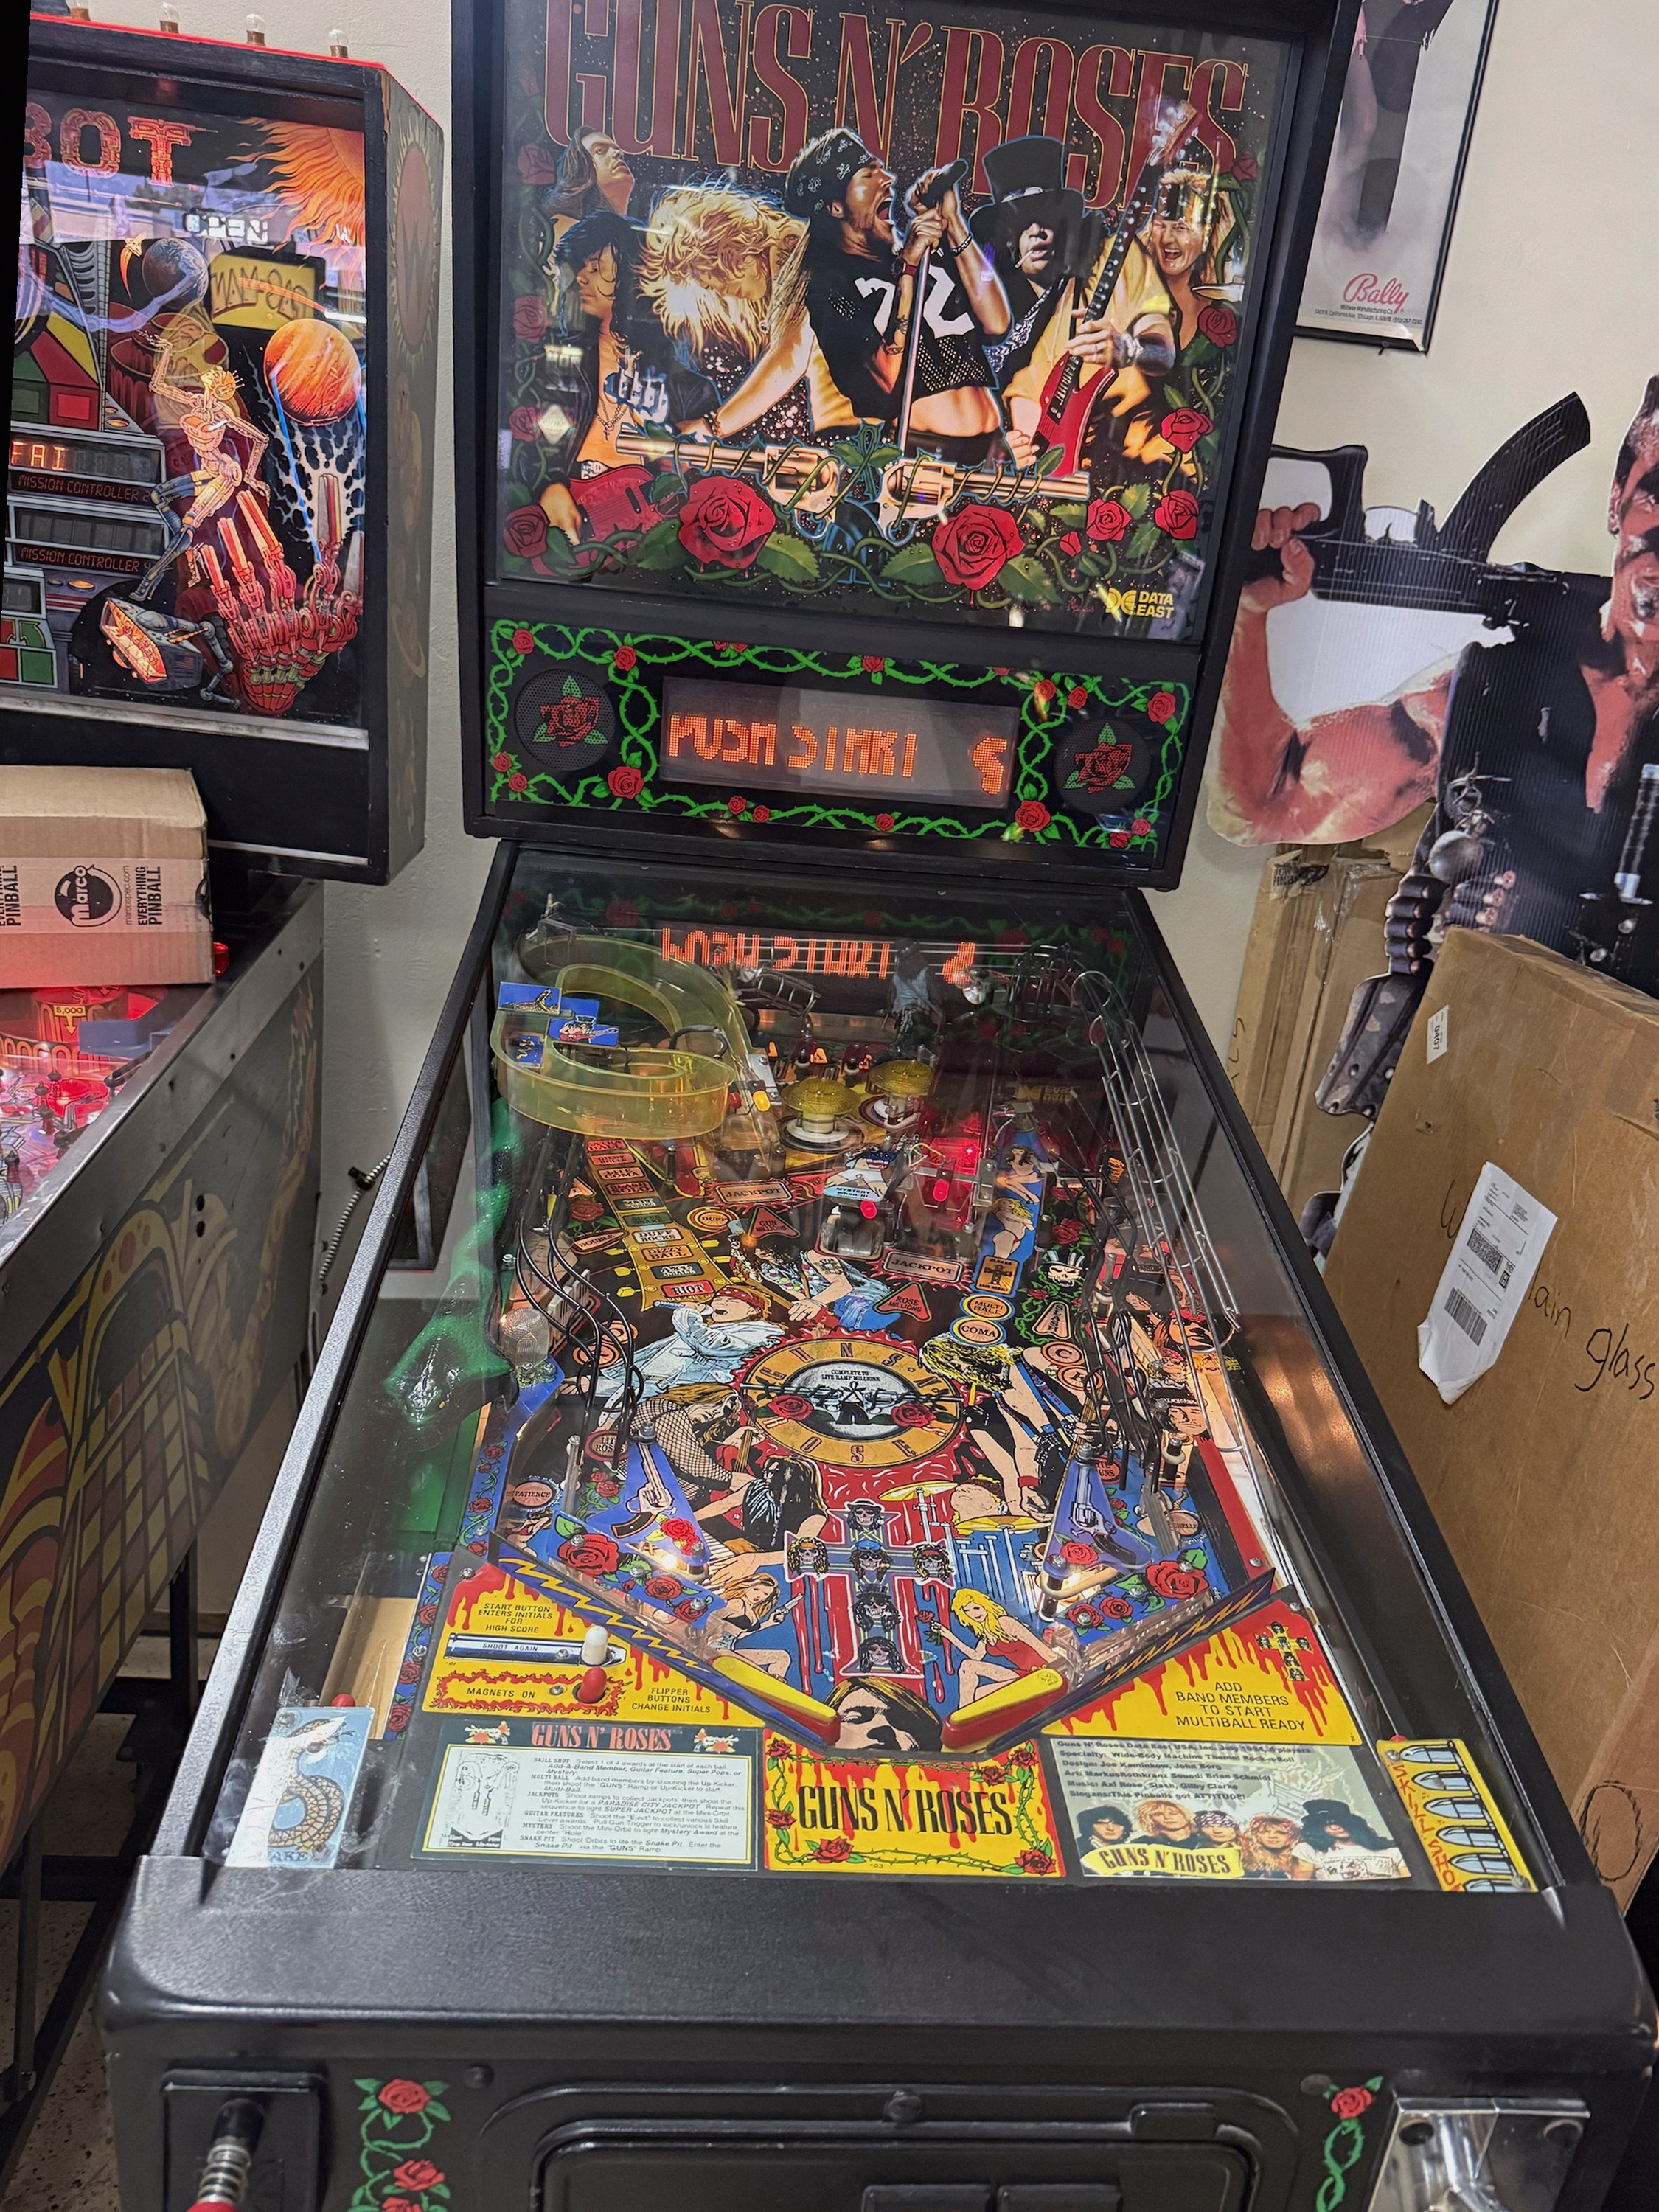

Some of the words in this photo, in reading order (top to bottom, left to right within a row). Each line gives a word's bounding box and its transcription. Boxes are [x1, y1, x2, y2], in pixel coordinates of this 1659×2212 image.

[544, 0, 813, 173] GUNS
[934, 25, 1248, 212] ROSES
[1343, 273, 1409, 314] Bally
[1357, 306, 1387, 314] Manufacturing
[18, 474, 63, 491] MISSION
[67, 481, 139, 501] CONTROLLER
[21, 547, 64, 563] MISSION
[69, 553, 139, 572] CONTROLLER
[1138, 591, 1173, 605] DATA
[1135, 604, 1175, 619] EAST
[3, 865, 21, 926] PINBALL
[71, 865, 90, 920] marco
[136, 866, 147, 925] EVERYTHING
[147, 866, 163, 925] PINBALL
[726, 1187, 782, 1197] JACKPOT
[835, 1186, 871, 1194] MYSTERY
[638, 1229, 674, 1237] DUFF
[579, 1234, 615, 1248] DOUBLE
[891, 1259, 955, 1276] JACKPOT
[672, 1284, 705, 1295] RIOT
[888, 1301, 922, 1312] MILLIONS
[896, 1295, 919, 1306] ROSE
[974, 1301, 1004, 1310] MULTI
[973, 1306, 1001, 1315] BALL
[1048, 1304, 1063, 1332] SLASH
[961, 1325, 996, 1338] COMA
[1055, 1349, 1072, 1358] C
[1574, 1322, 1656, 1400] glass
[596, 1444, 627, 1453] ROSS
[515, 1490, 551, 1498] PATIENCE
[484, 1603, 512, 1611] START
[515, 1604, 551, 1613] BUTTON
[478, 1610, 513, 1618] ENTERS
[515, 1610, 553, 1619] INITIALS
[485, 1624, 509, 1632] HIGH
[510, 1625, 539, 1633] SCORE
[514, 1644, 538, 1652] AGAIN
[651, 1687, 689, 1696] FLIPPER
[1215, 1681, 1242, 1691] ADD
[466, 1686, 515, 1697] MAGNETS
[521, 1691, 536, 1699] ON
[647, 1694, 691, 1703] BUTTONS
[1175, 1692, 1216, 1704] BAND
[1218, 1694, 1289, 1706] MEMBERS
[631, 1703, 670, 1711] CHANGE
[672, 1703, 711, 1714] INITIALS
[1200, 1704, 1220, 1715] TO
[1225, 1706, 1272, 1717] START
[1175, 1716, 1258, 1729] MULTIBALL
[1260, 1719, 1306, 1731] READY
[531, 1723, 582, 1747] GUNS
[609, 1728, 672, 1751] ROSES
[1060, 1750, 1107, 1759] Specialty:
[1111, 1751, 1161, 1760] Wide-Body
[1062, 1760, 1097, 1768] Design:
[1180, 1782, 1205, 1790] Gilby
[1392, 1764, 1435, 1834] SKILL
[798, 1785, 879, 1831] GUNS
[885, 1788, 911, 1832] N'
[917, 1790, 1013, 1836] ROSES
[1099, 1848, 1150, 1869] GUNS
[1172, 1852, 1231, 1874] ROSES
